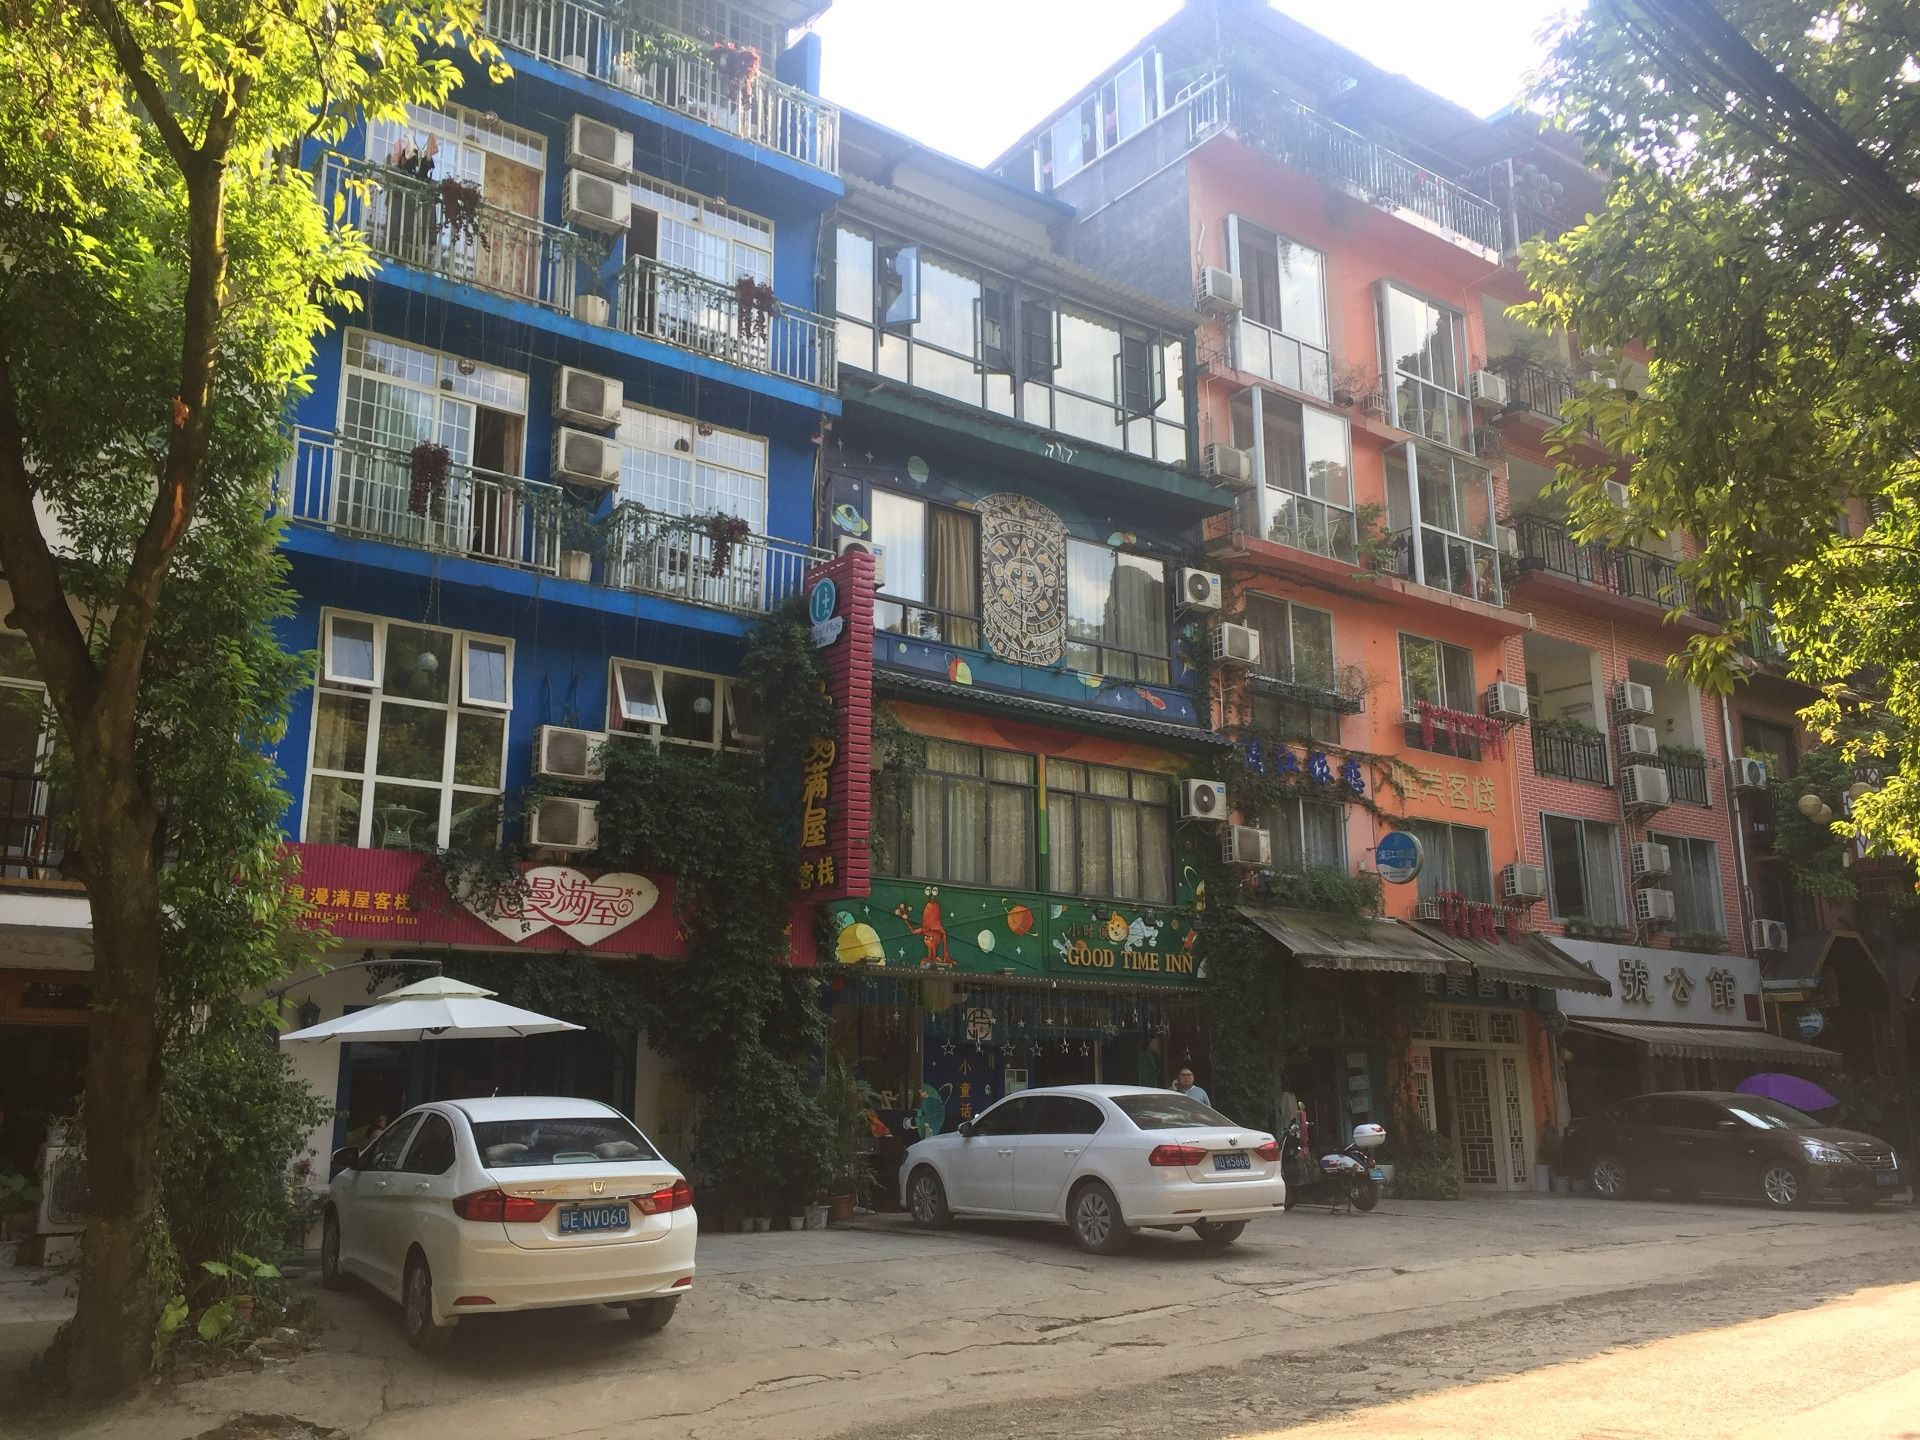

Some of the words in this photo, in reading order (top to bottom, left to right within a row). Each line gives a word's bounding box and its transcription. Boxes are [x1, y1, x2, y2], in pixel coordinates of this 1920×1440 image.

[1067, 947, 1115, 968] GOOD
[1120, 950, 1160, 972] TIME
[1165, 953, 1193, 974] INN
